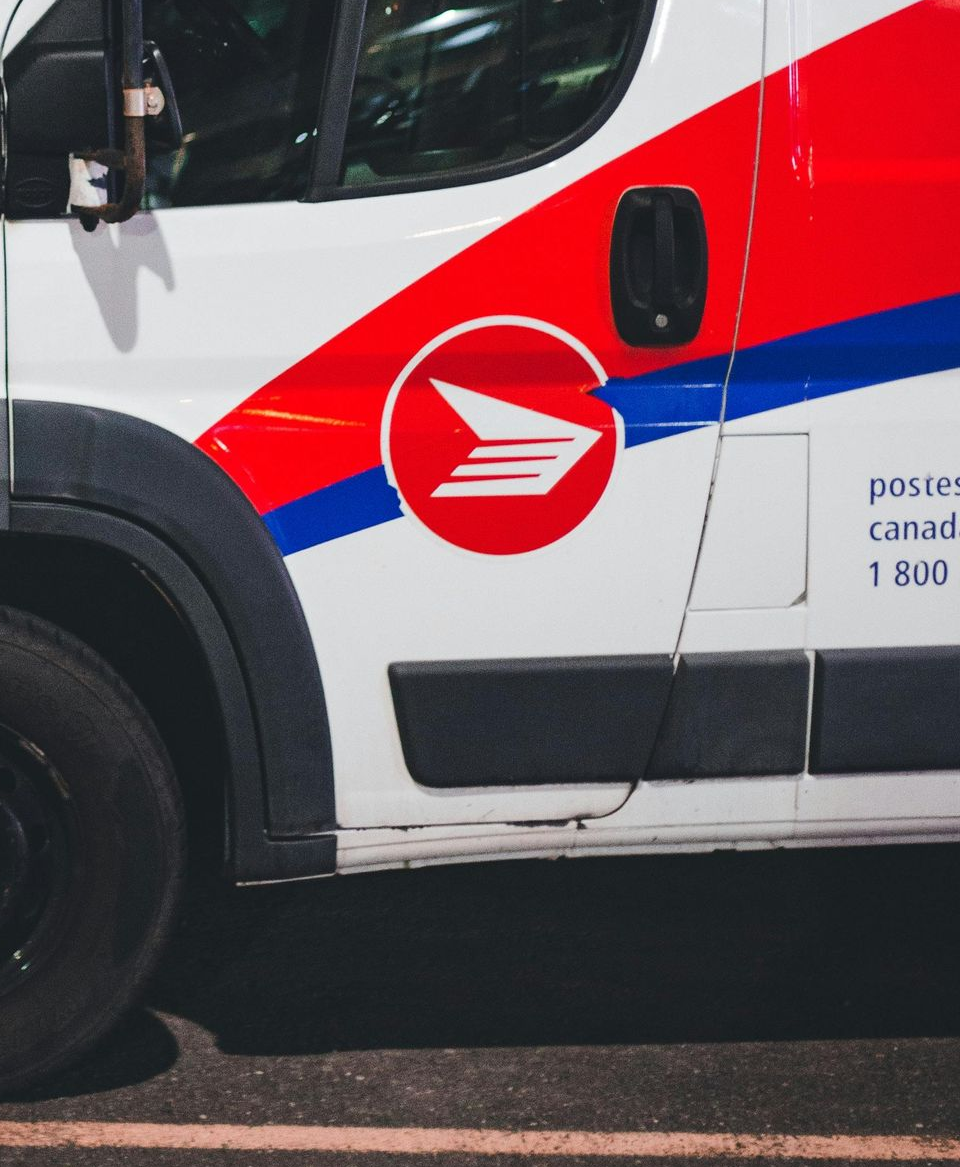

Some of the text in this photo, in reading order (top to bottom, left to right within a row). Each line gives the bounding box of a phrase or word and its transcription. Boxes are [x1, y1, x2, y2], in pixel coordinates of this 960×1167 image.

[869, 512, 960, 541] canad
[869, 559, 949, 587] 1 800
